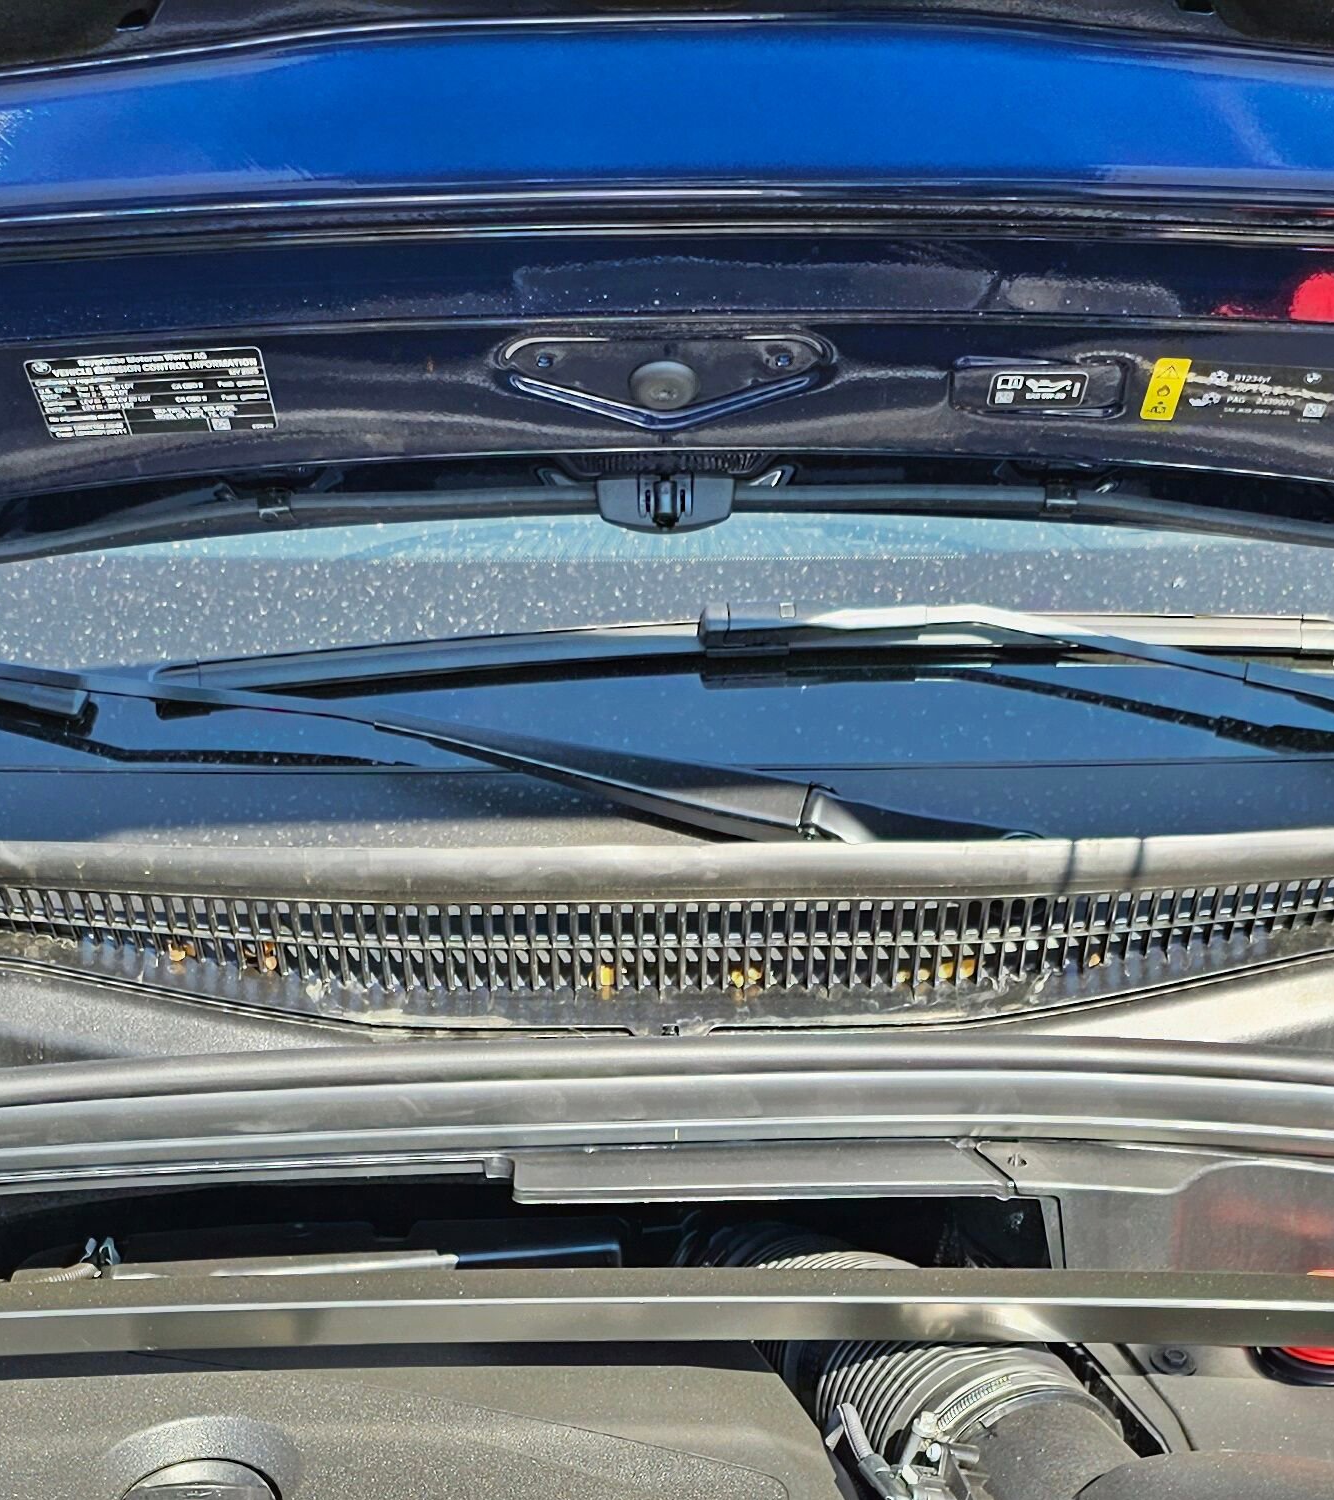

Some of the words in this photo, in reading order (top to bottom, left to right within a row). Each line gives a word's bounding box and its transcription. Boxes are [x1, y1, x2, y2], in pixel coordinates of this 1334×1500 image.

[141, 361, 188, 371] CONTROL
[188, 357, 257, 368] INFORMATION
[1227, 396, 1245, 404] PAG
